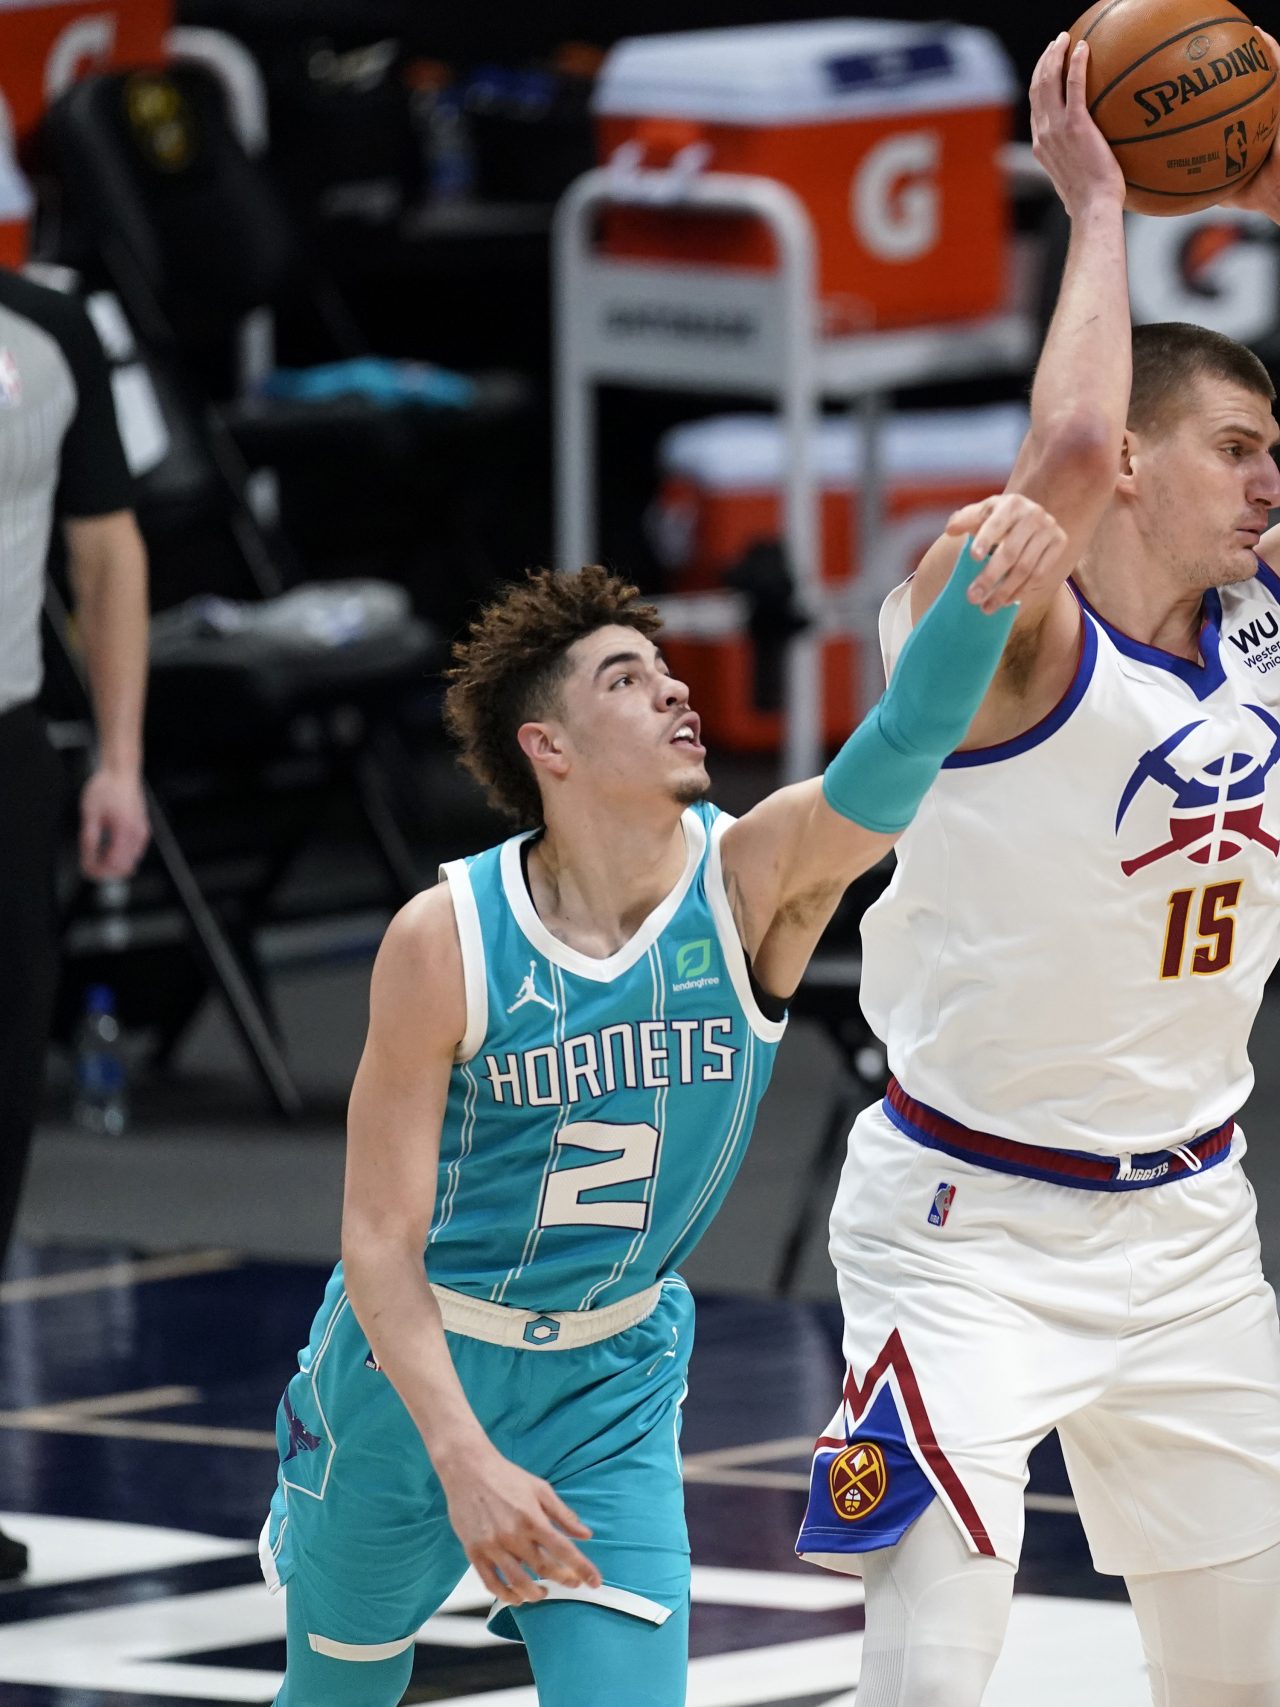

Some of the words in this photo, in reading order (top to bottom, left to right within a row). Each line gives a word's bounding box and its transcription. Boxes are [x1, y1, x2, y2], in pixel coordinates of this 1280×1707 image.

[1133, 36, 1271, 128] SPALDING
[850, 130, 941, 261] G
[1228, 611, 1279, 654] WU
[1159, 879, 1245, 981] 15
[672, 976, 720, 992] lendingtree
[481, 1016, 741, 1107] HORNETS
[538, 1119, 660, 1233] 2
